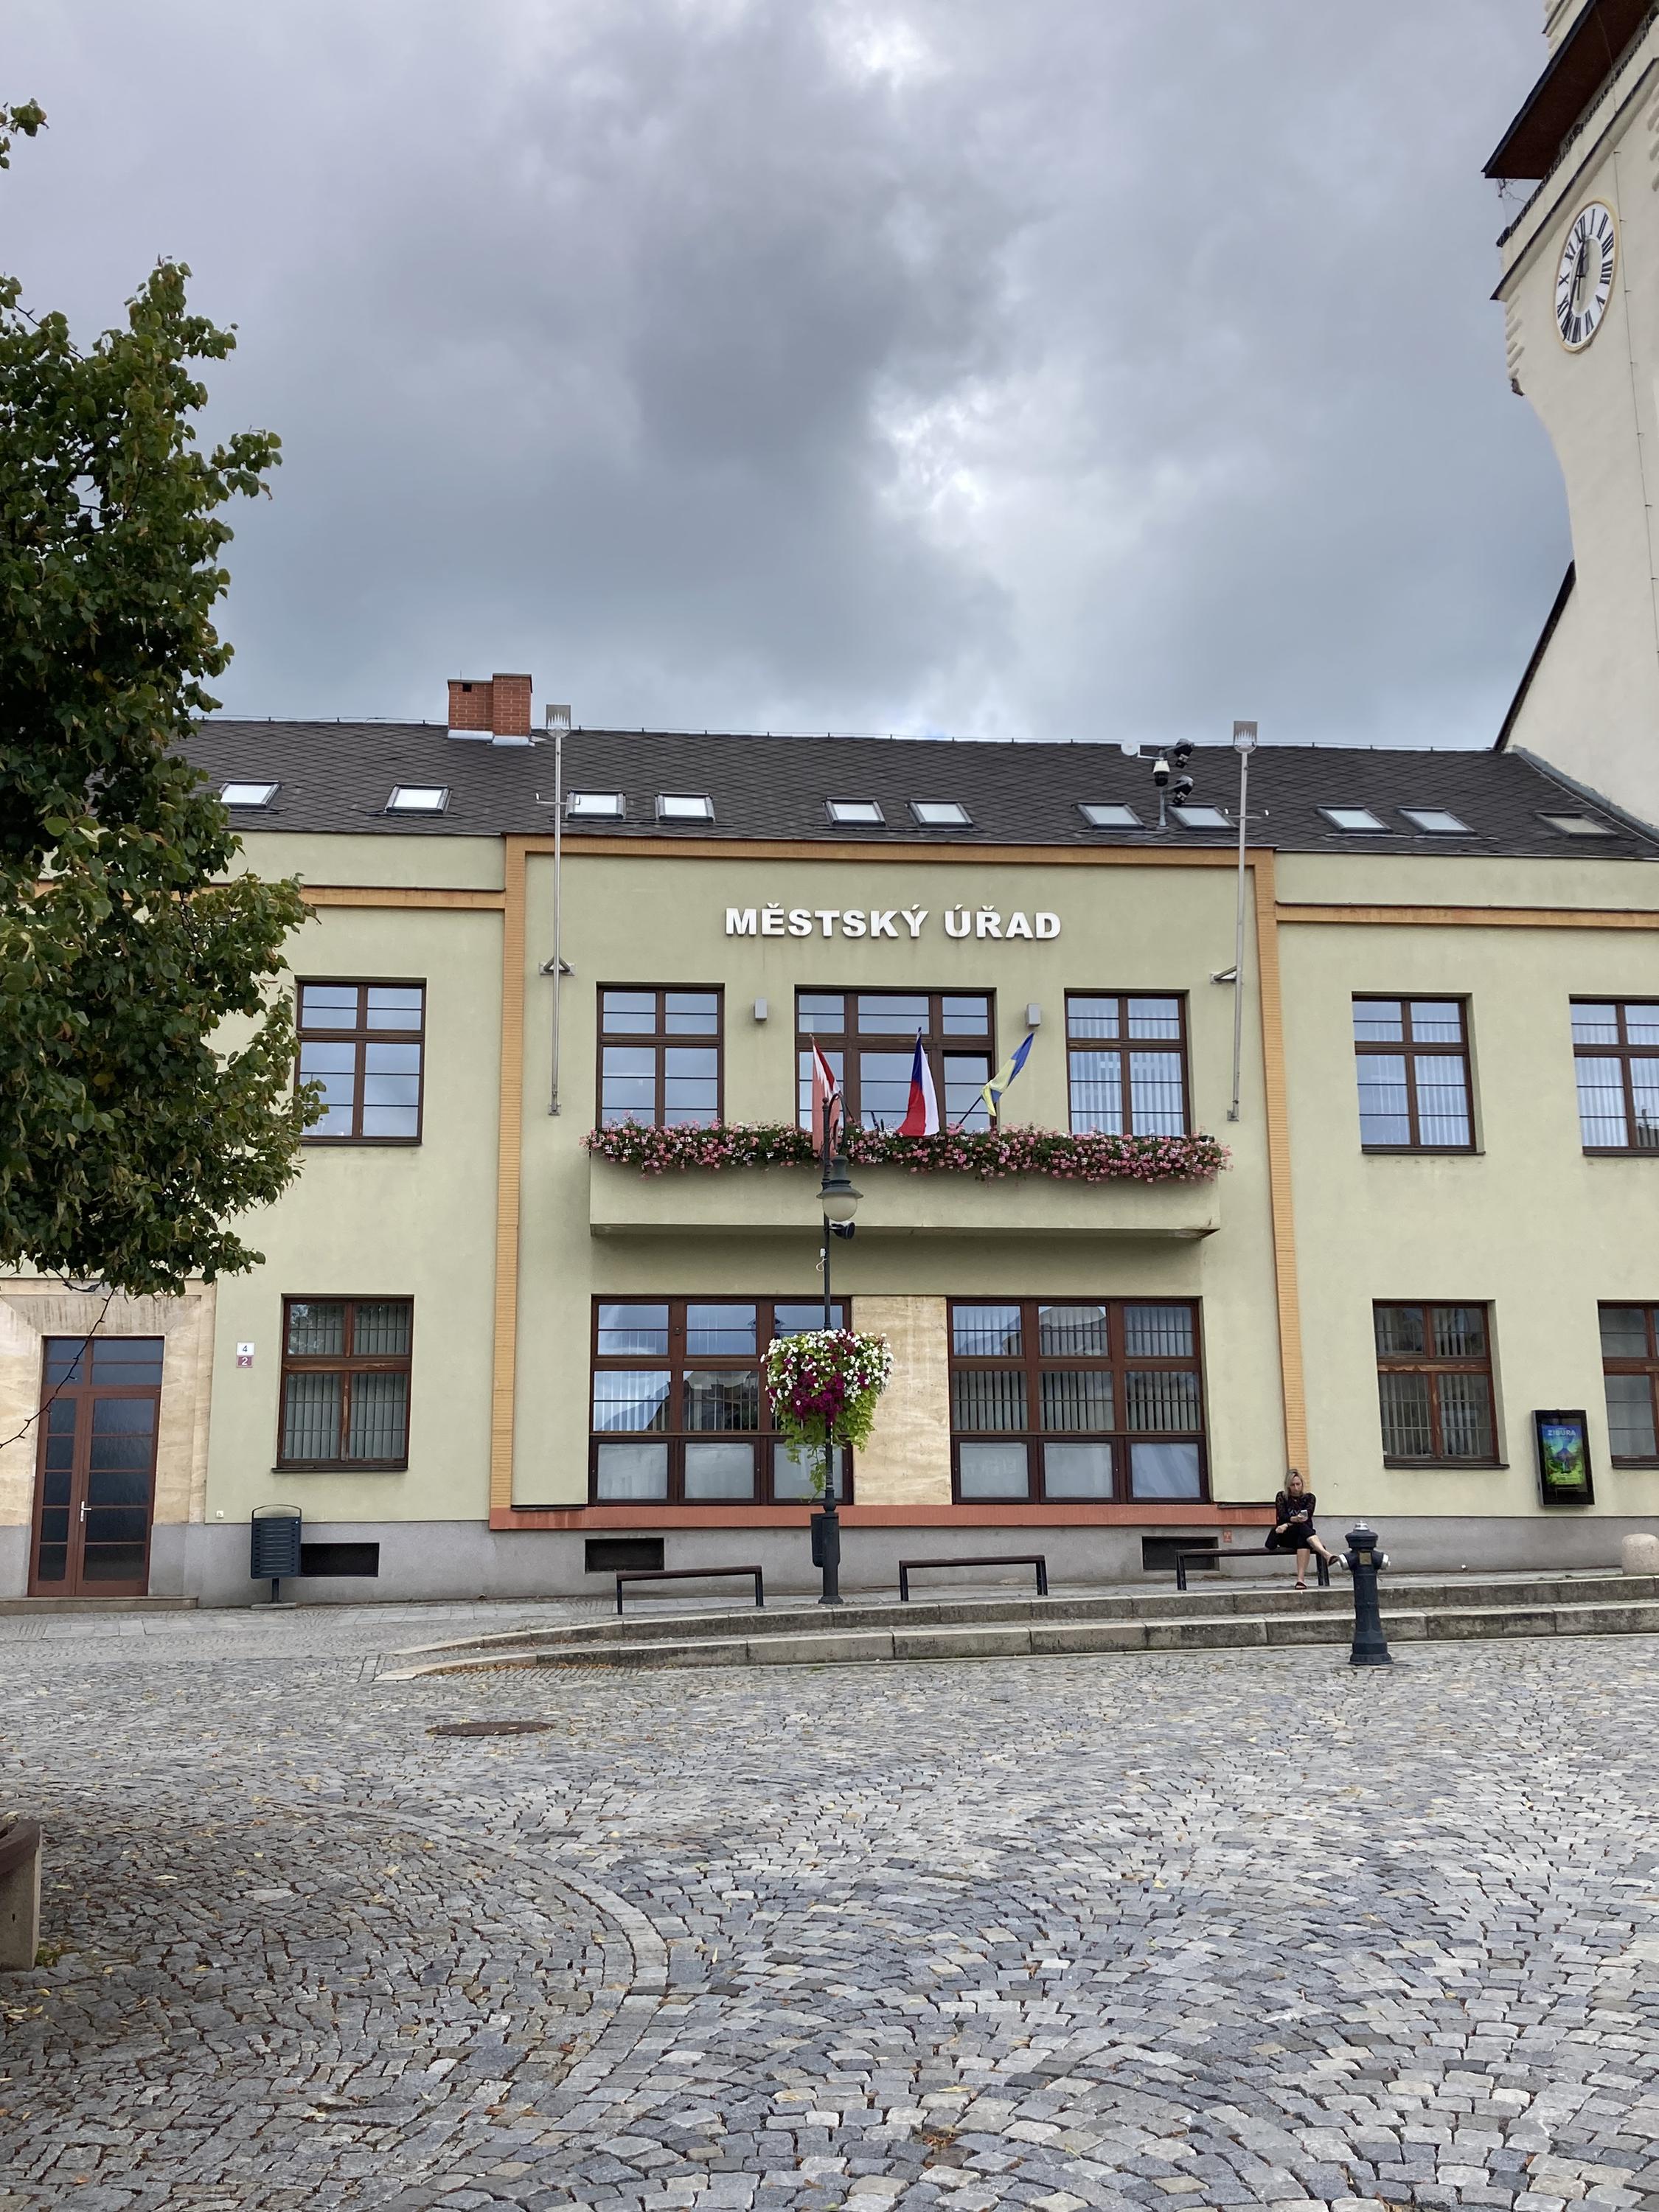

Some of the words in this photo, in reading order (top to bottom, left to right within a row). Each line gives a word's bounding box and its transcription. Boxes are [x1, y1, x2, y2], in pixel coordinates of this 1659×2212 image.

[1589, 209, 1596, 235] I
[1596, 212, 1609, 240] II
[1601, 231, 1614, 258] III
[1558, 272, 1571, 287] X
[1599, 260, 1613, 285] IIII
[1596, 294, 1607, 312] V
[725, 902, 929, 938] MĚSTSKÝ
[945, 903, 1062, 939] ÚŘAD
[241, 1357, 248, 1366] 2
[242, 1345, 248, 1353] 4
